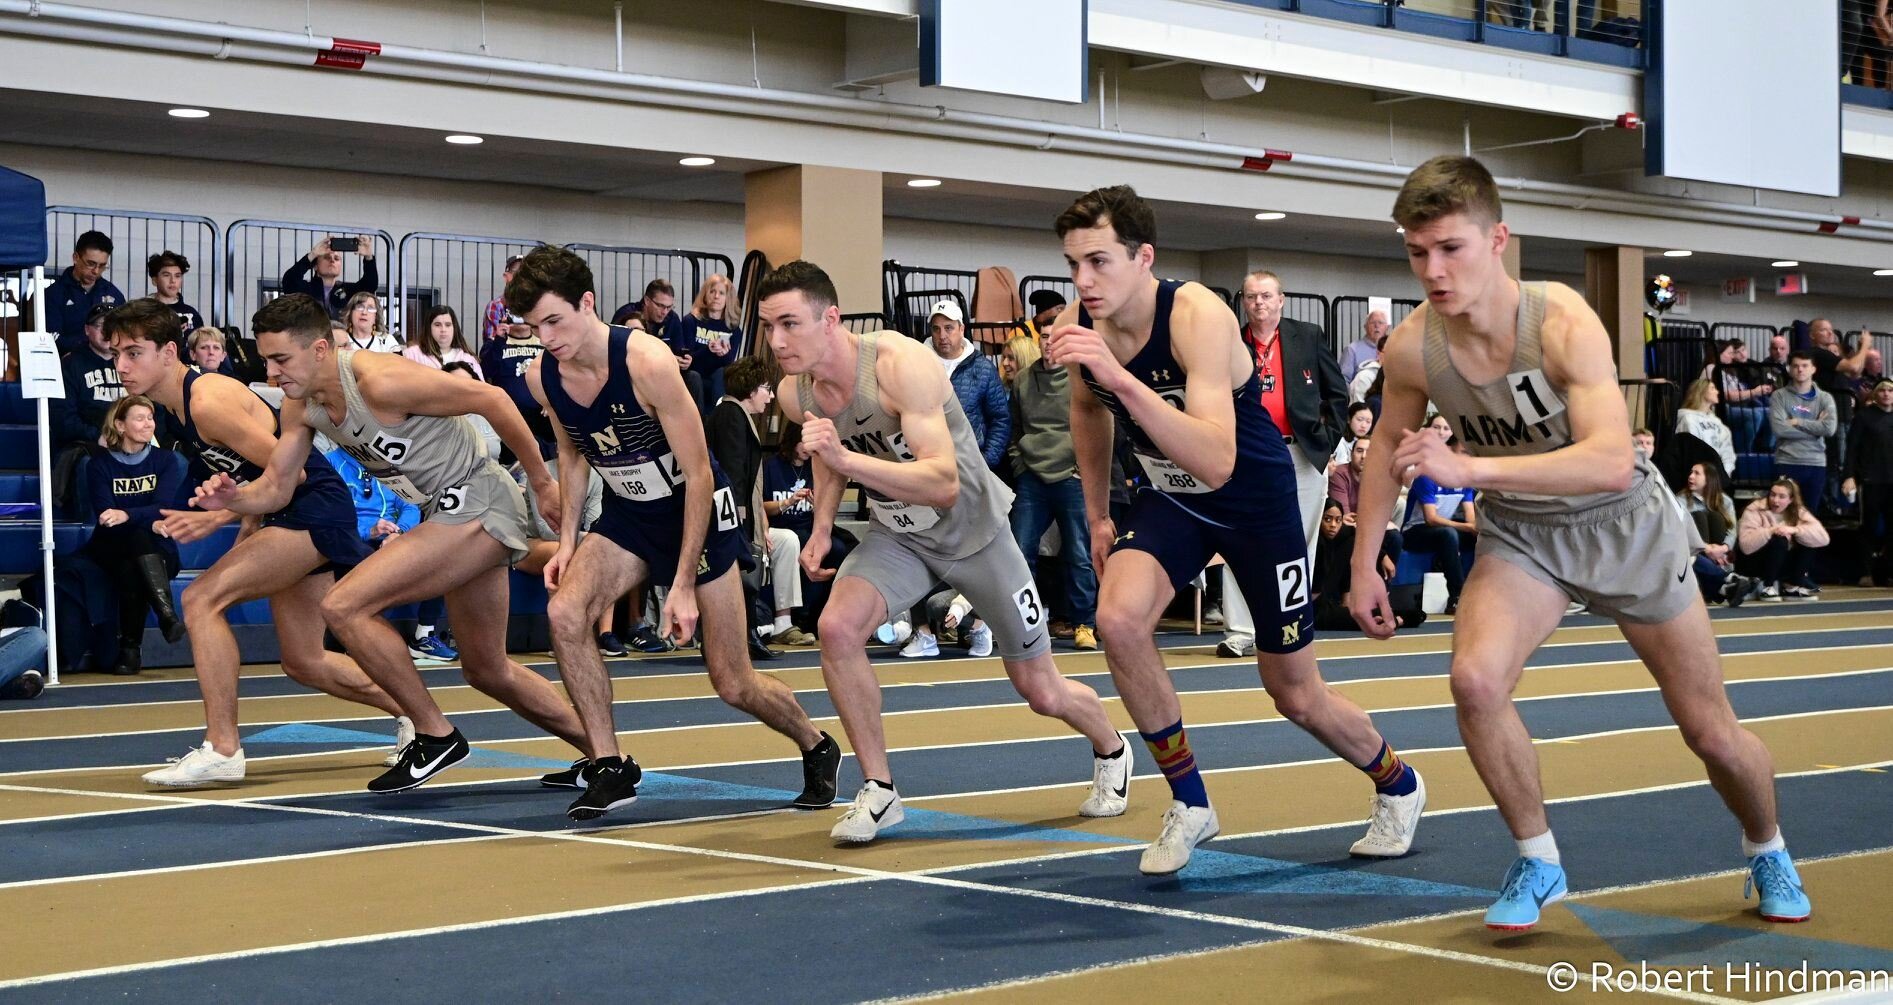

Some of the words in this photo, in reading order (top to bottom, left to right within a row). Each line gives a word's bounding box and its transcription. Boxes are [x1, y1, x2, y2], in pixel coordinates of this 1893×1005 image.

[502, 347, 545, 359] MIDSHIPM
[1515, 375, 1550, 418] 1
[372, 435, 407, 461] 5
[590, 425, 621, 452] N
[840, 430, 890, 455] RMY
[600, 445, 623, 457] NAVY
[114, 476, 155, 492] NAVY
[621, 480, 647, 495] 158
[1163, 473, 1197, 488] 268
[720, 490, 736, 526] 4
[892, 514, 915, 528] 84
[1281, 564, 1303, 608] 2
[1018, 588, 1040, 625] 3
[1281, 621, 1299, 643] N
